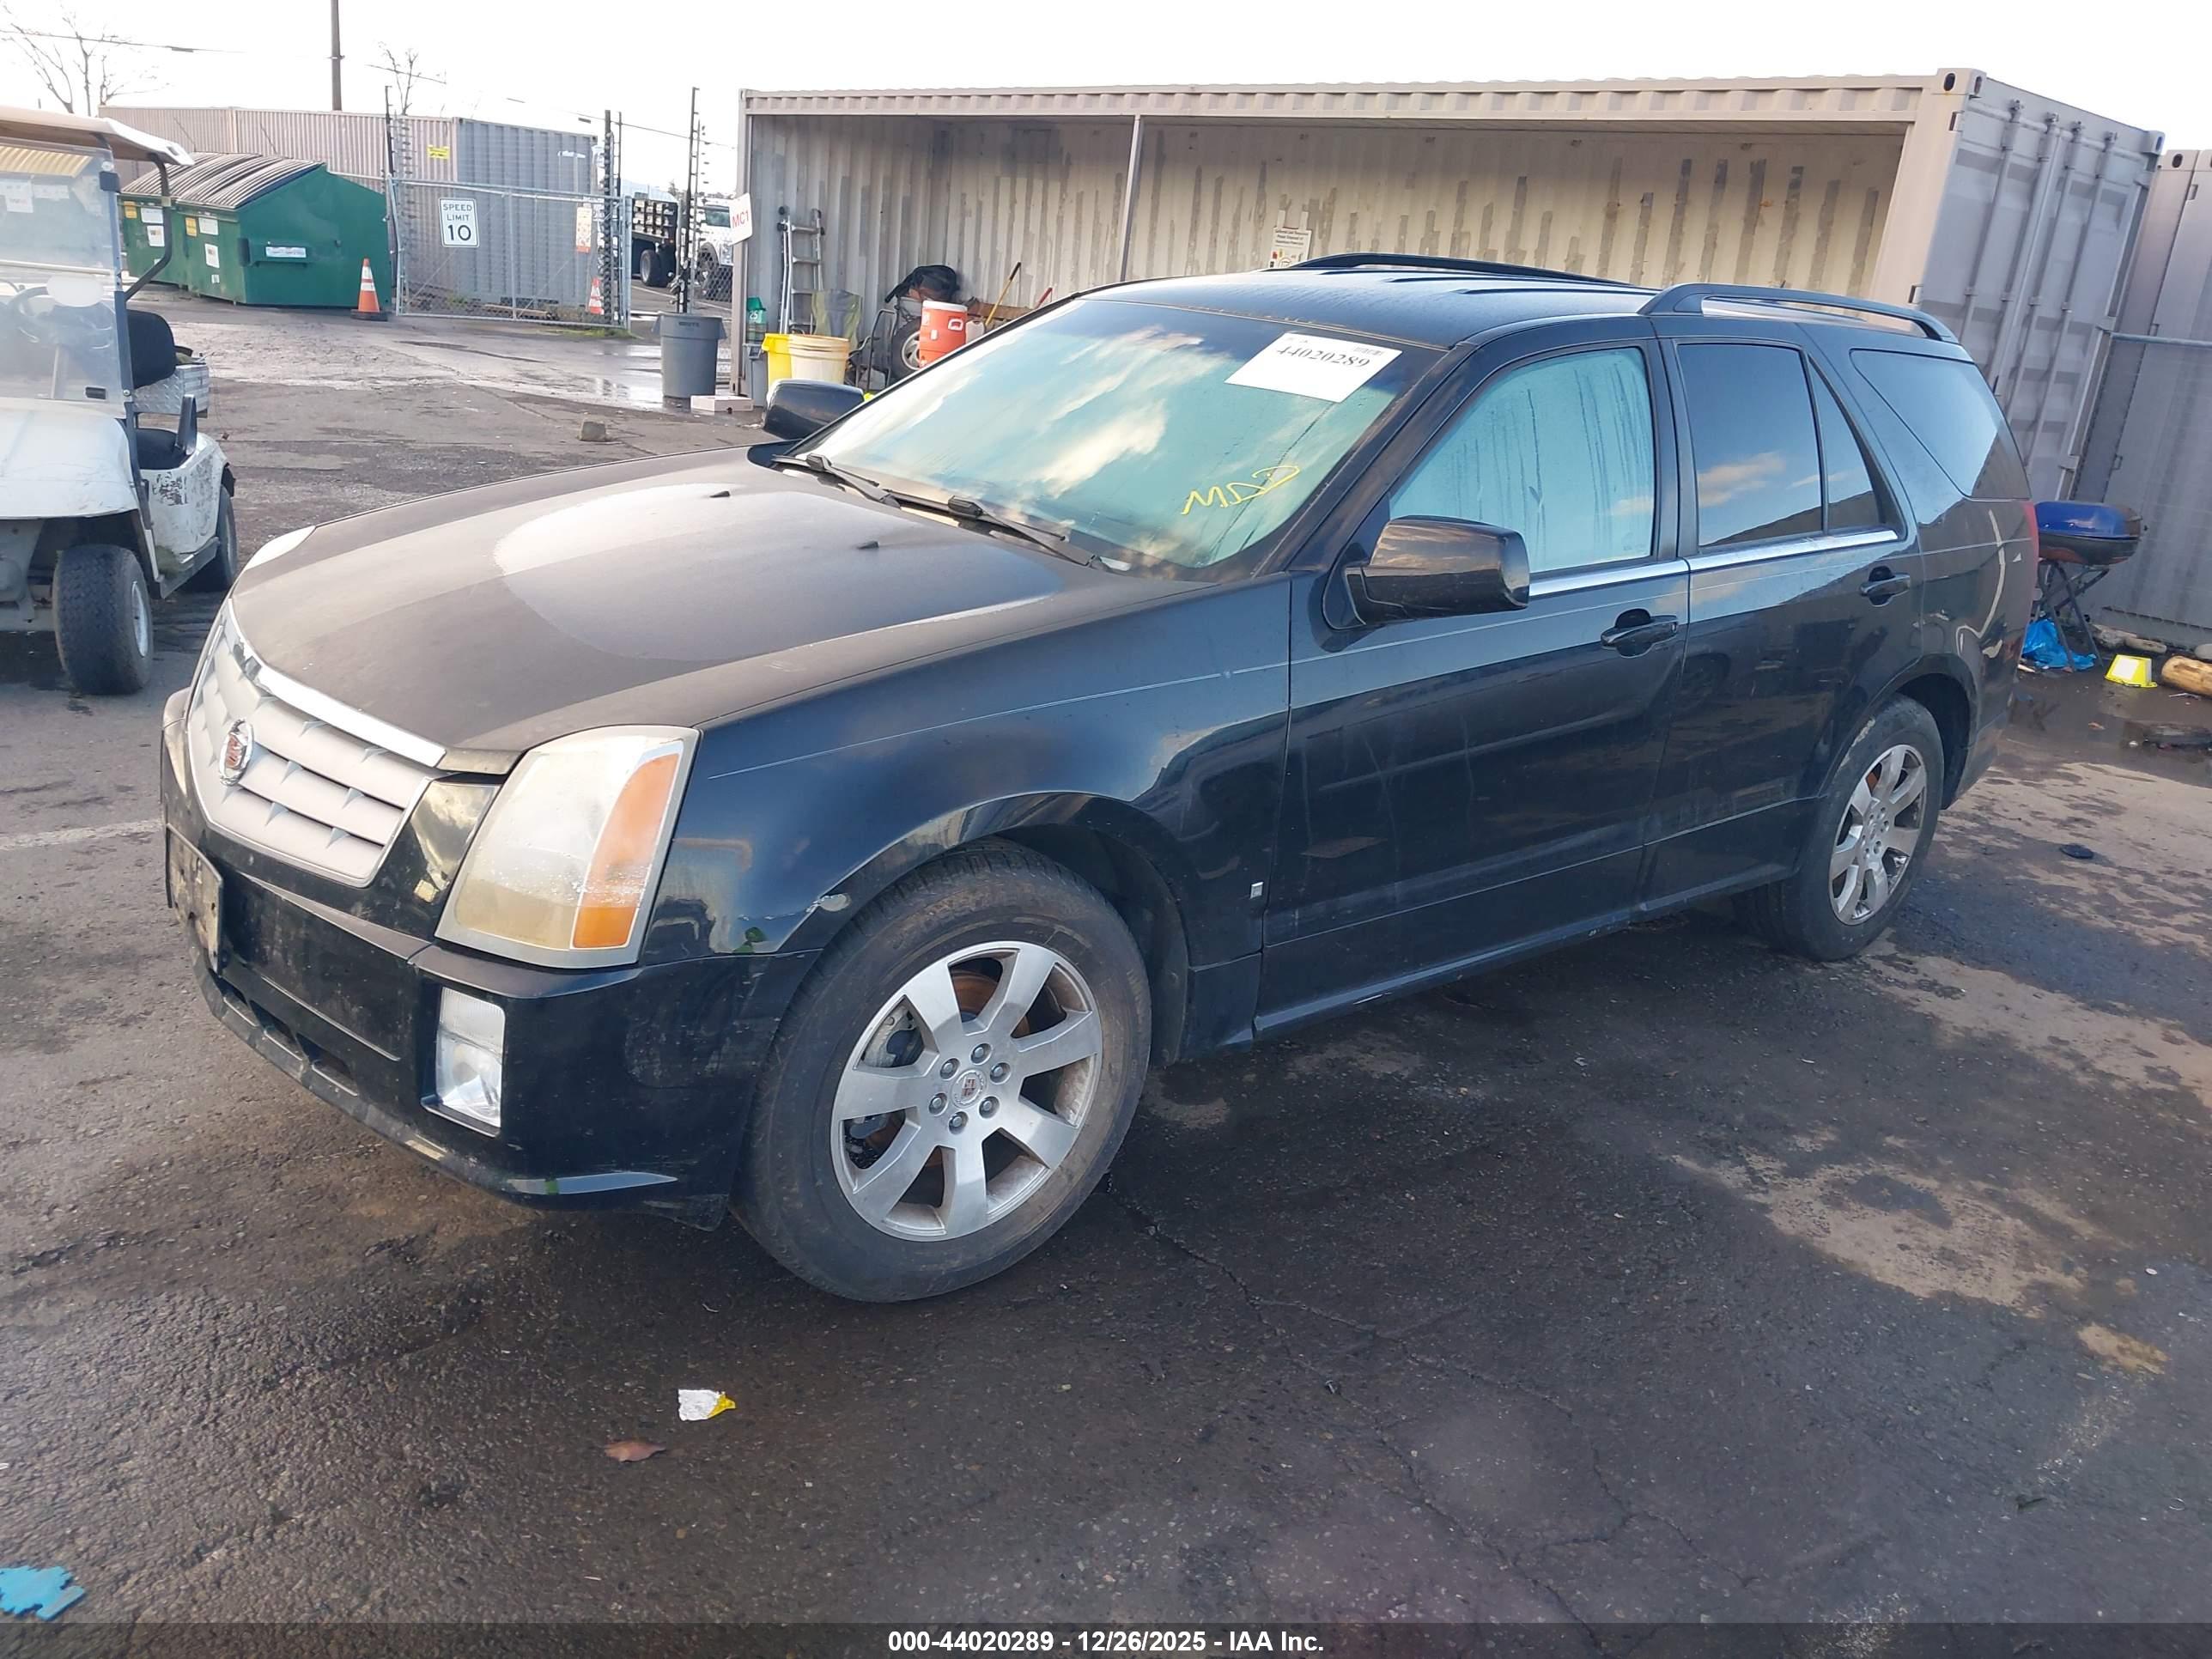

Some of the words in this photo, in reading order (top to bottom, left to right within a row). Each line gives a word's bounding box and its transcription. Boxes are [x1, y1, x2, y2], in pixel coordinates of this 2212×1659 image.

[732, 210, 749, 228] MC1
[447, 224, 471, 240] 10
[1277, 346, 1370, 368] 44020289
